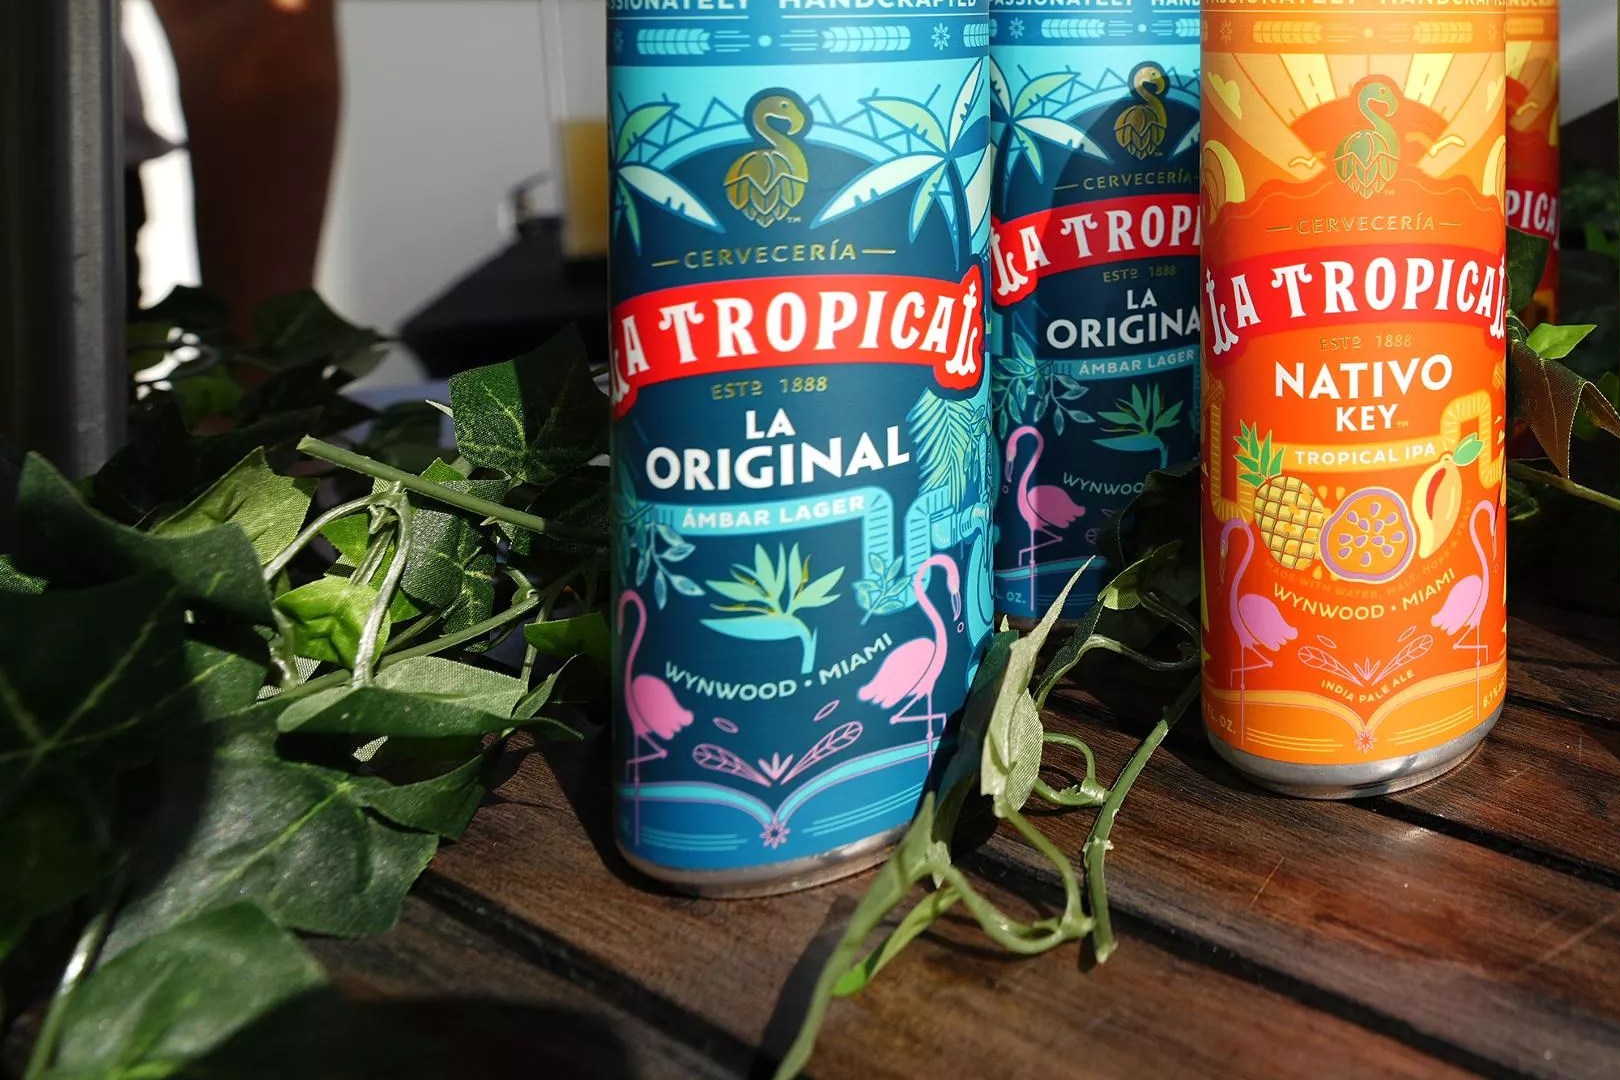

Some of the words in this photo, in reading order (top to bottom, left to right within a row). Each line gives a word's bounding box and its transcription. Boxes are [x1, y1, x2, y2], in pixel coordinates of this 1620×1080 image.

[1083, 168, 1192, 191] CERVECERÍA
[1297, 211, 1434, 234] CERVECERÍA
[685, 239, 857, 269] CERVECERÍA
[991, 224, 1051, 296] LA
[1127, 288, 1157, 309] LA
[1206, 266, 1261, 355] LA
[658, 280, 979, 376] TROPICAL
[1376, 333, 1414, 349] 1888
[1079, 356, 1141, 375] ÁMBAR
[1148, 350, 1194, 369] LAGER
[1274, 354, 1453, 400] NATIVO
[779, 376, 828, 394] 1888
[745, 408, 796, 440] LA
[1336, 403, 1400, 432] KEY
[646, 426, 910, 491] ORIGINAL
[1296, 446, 1398, 466] TROPICAL
[1405, 443, 1436, 461] IPA
[682, 507, 770, 528] ÁMBAR
[779, 495, 865, 523] LAGER
[1006, 591, 1027, 604] OZ.
[1274, 582, 1385, 620] WYNWOOD
[1402, 567, 1455, 610] MIAMI
[664, 661, 797, 700] WYNWOOD
[819, 633, 894, 685] MIAMI
[1321, 680, 1354, 702] INDIA
[1359, 681, 1389, 704] PALE
[1392, 670, 1415, 688] ALE
